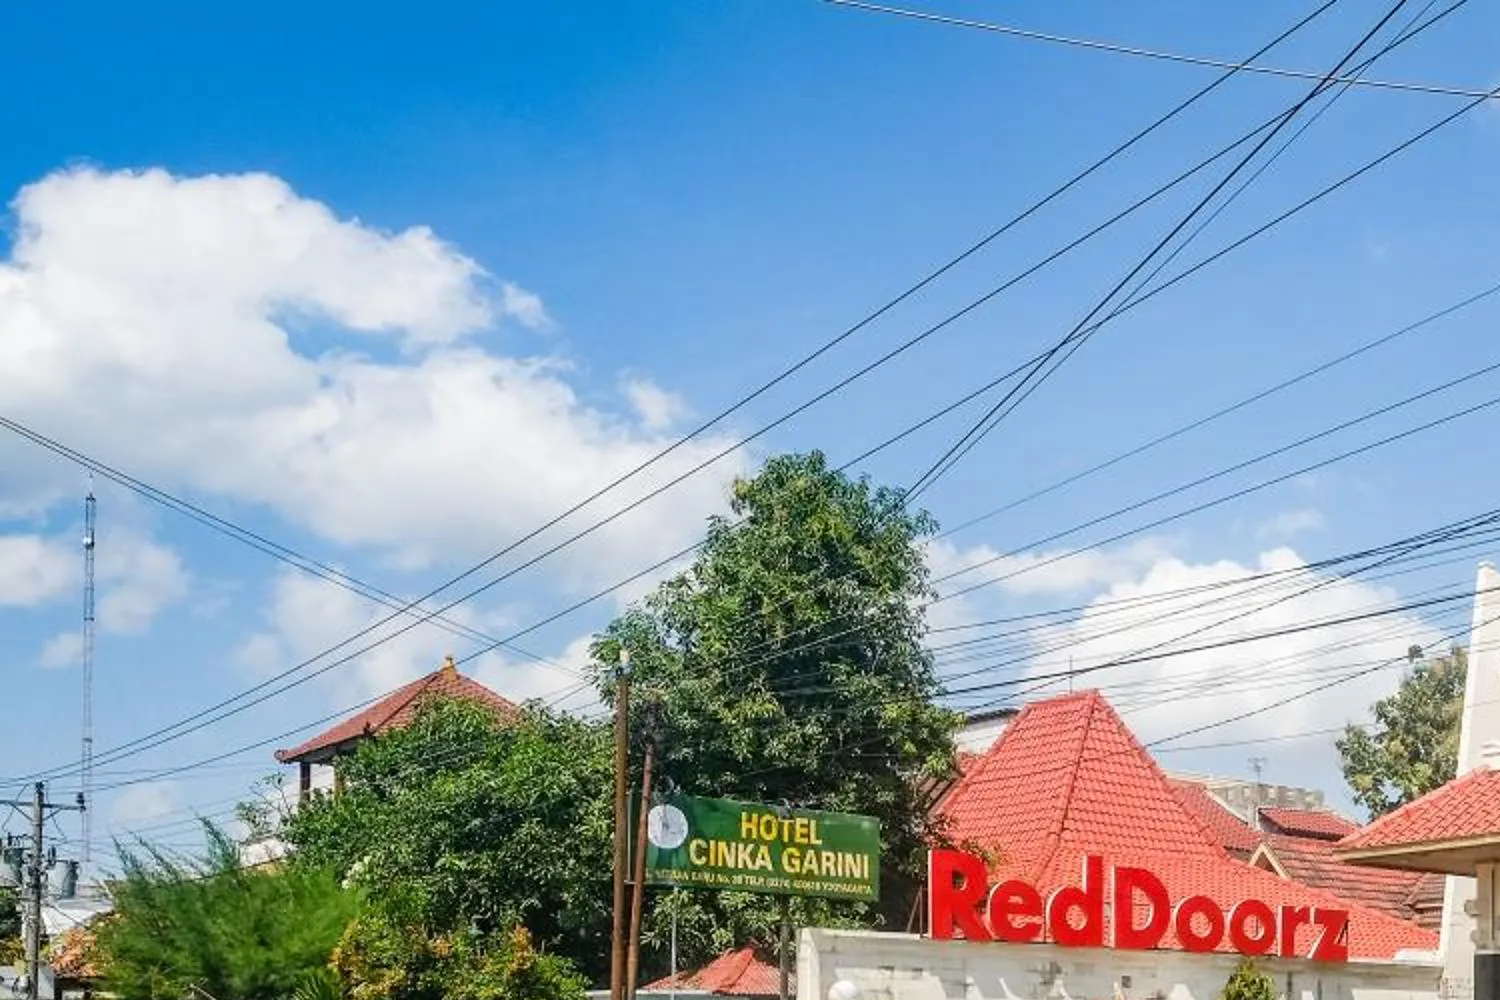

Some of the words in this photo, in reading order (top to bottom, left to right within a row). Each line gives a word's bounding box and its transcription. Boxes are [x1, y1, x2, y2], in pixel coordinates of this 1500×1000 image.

[740, 811, 823, 845] HOTEL
[689, 839, 773, 872] CINKA
[781, 847, 869, 880] GARINI
[928, 848, 1350, 962] RedDoorz
